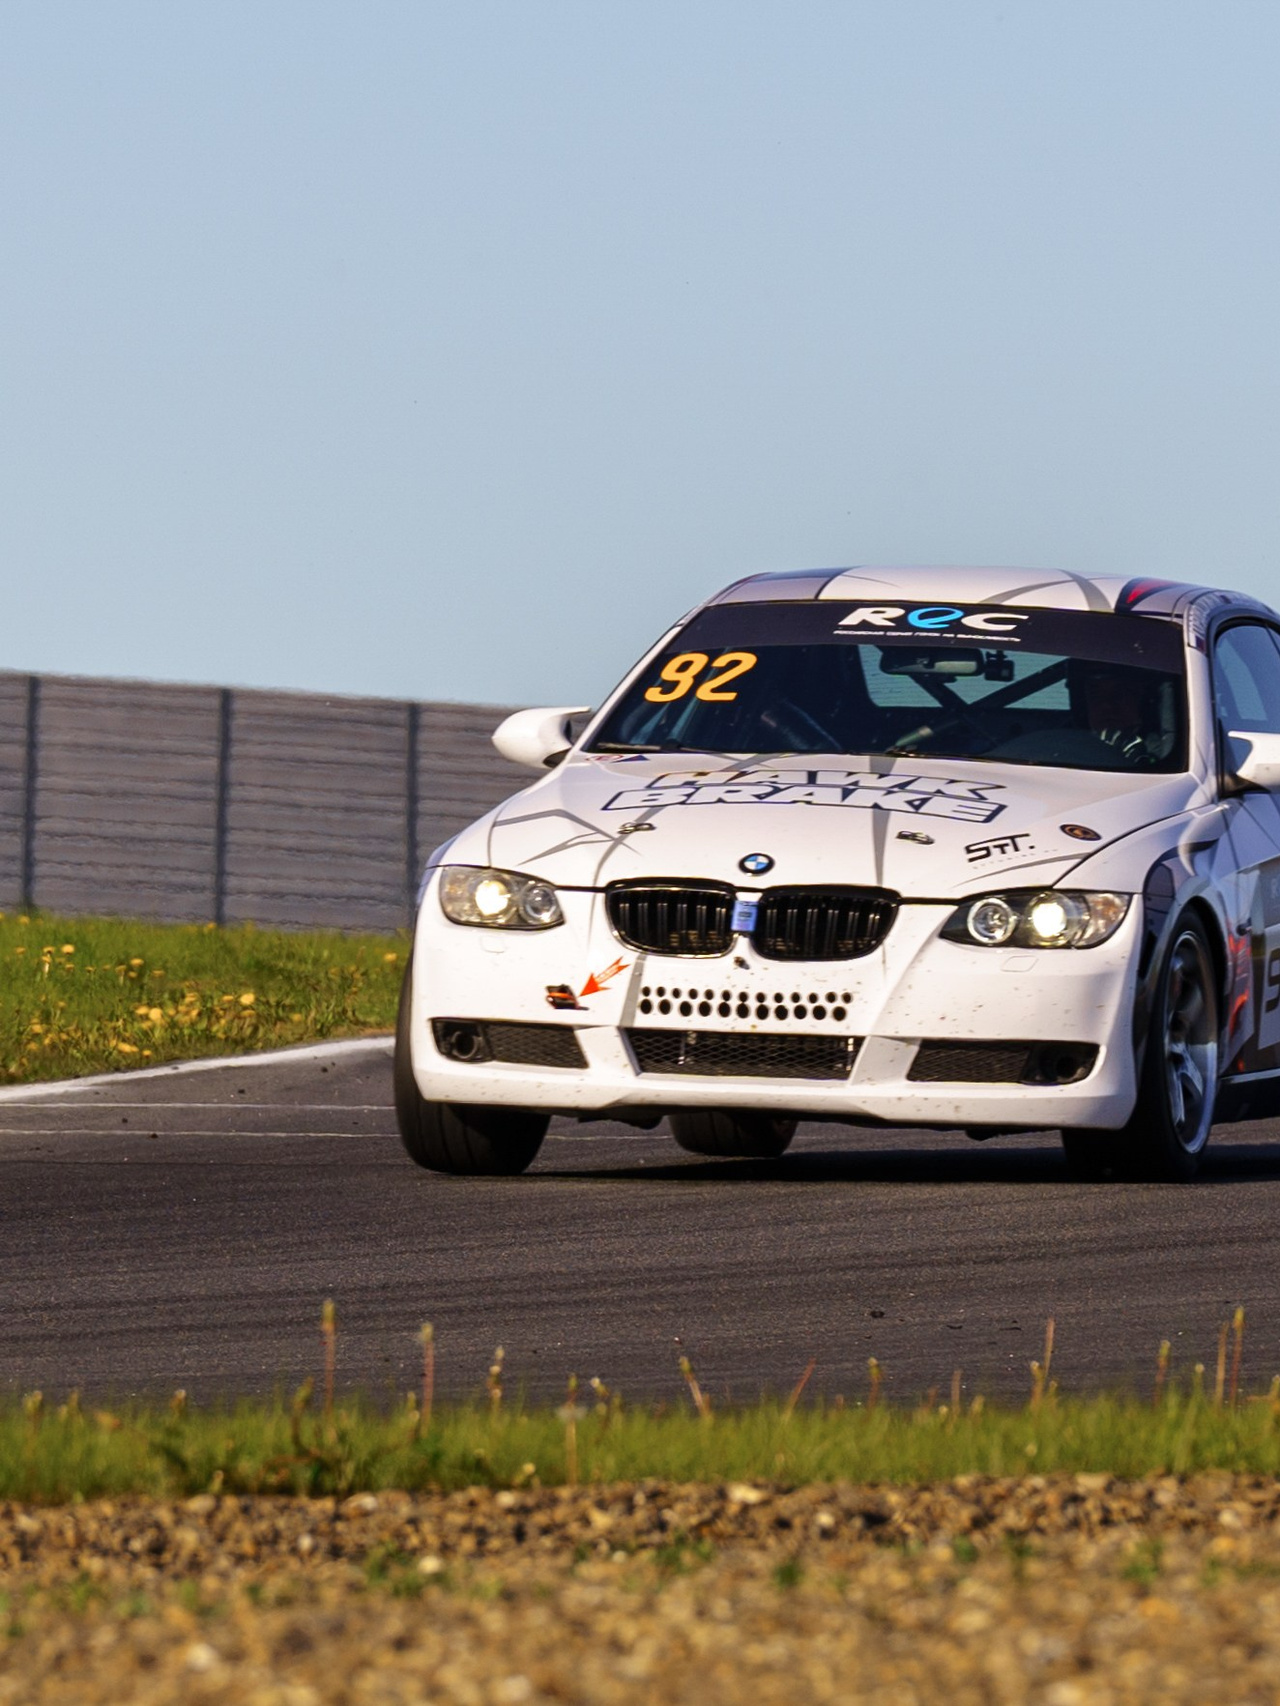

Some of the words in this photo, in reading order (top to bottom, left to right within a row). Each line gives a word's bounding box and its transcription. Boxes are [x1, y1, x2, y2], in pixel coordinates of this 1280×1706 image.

[644, 652, 757, 702] 92
[600, 784, 1008, 823] BRAKE
[645, 770, 1006, 802] HAWK
